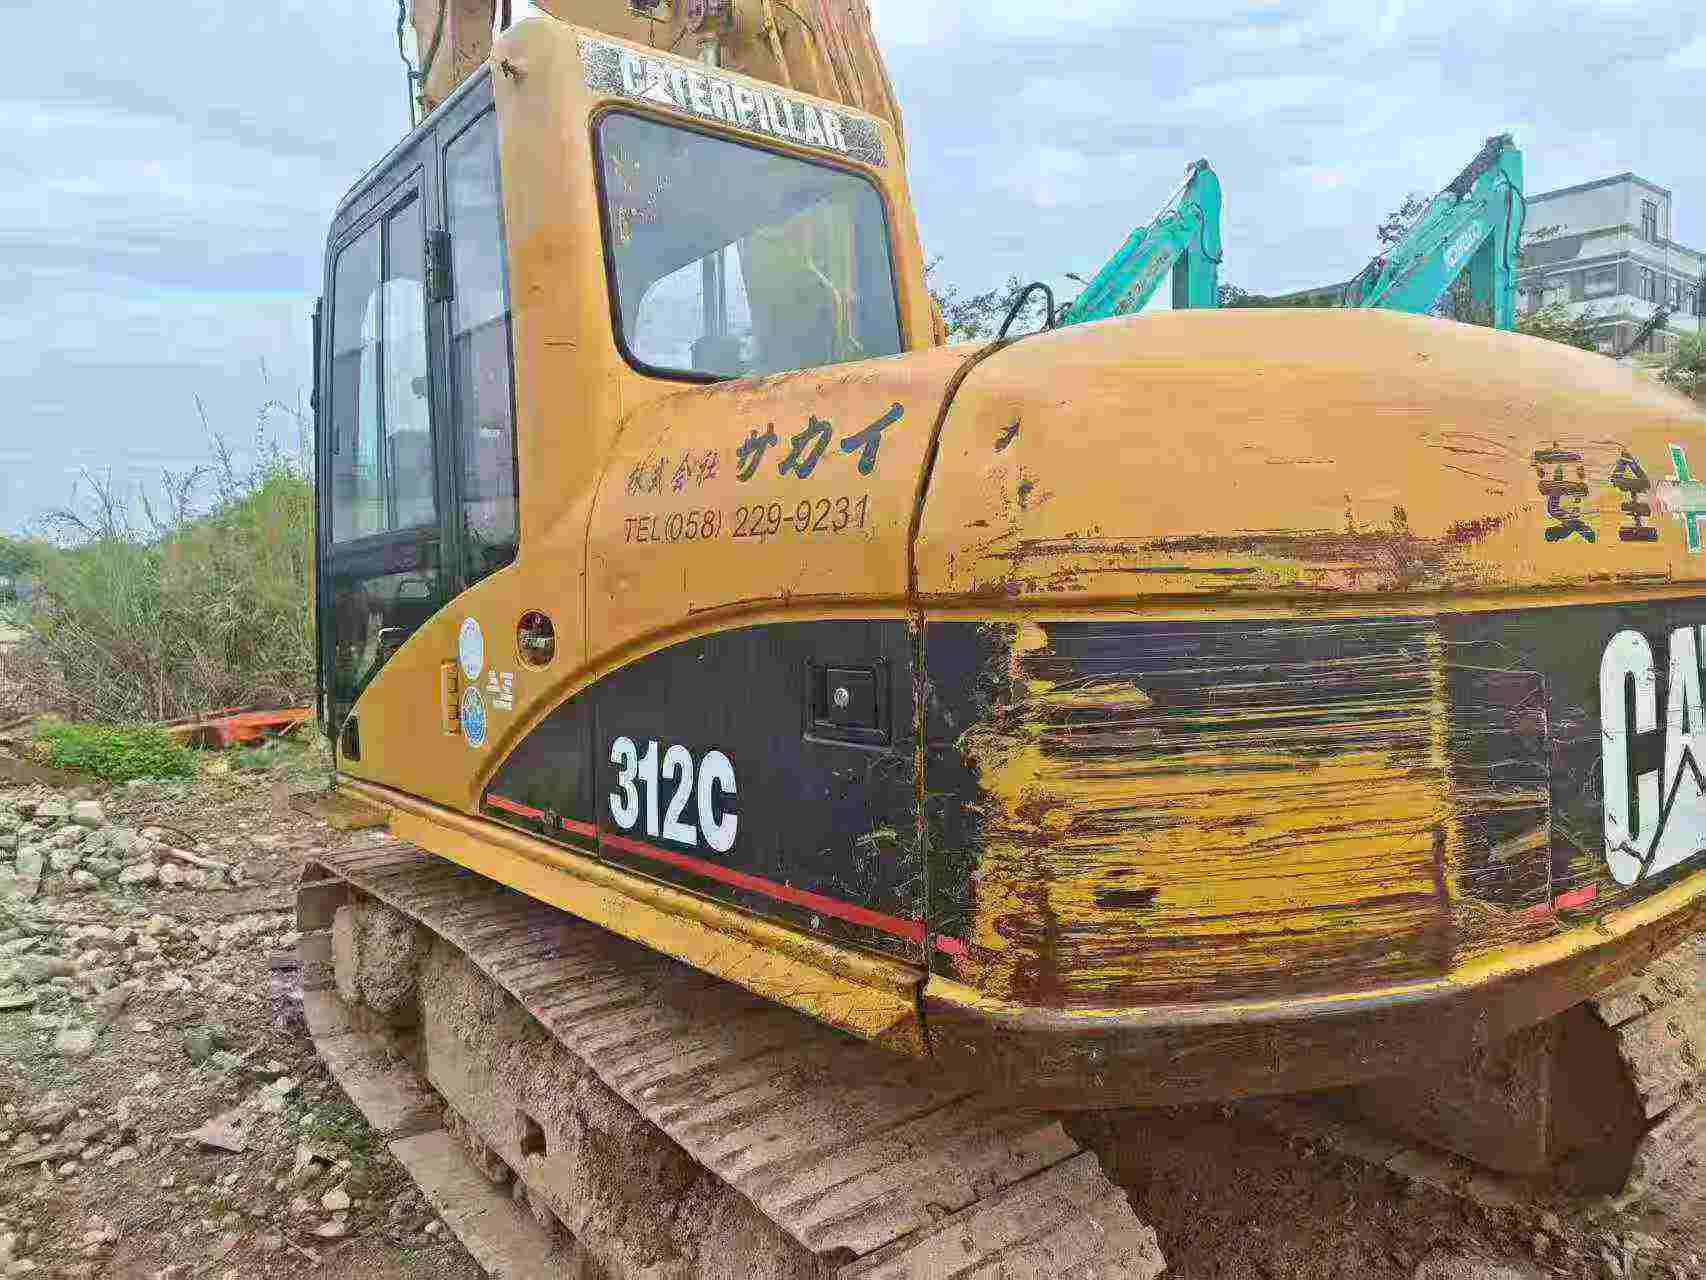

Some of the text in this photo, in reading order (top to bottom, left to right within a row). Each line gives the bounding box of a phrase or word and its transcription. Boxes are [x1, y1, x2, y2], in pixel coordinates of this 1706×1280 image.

[620, 52, 846, 151] CATERPILLAR
[736, 402, 904, 482] サカイ
[733, 495, 868, 538] 229-9231
[609, 736, 738, 852] 312C
[1600, 624, 1706, 885] CA
